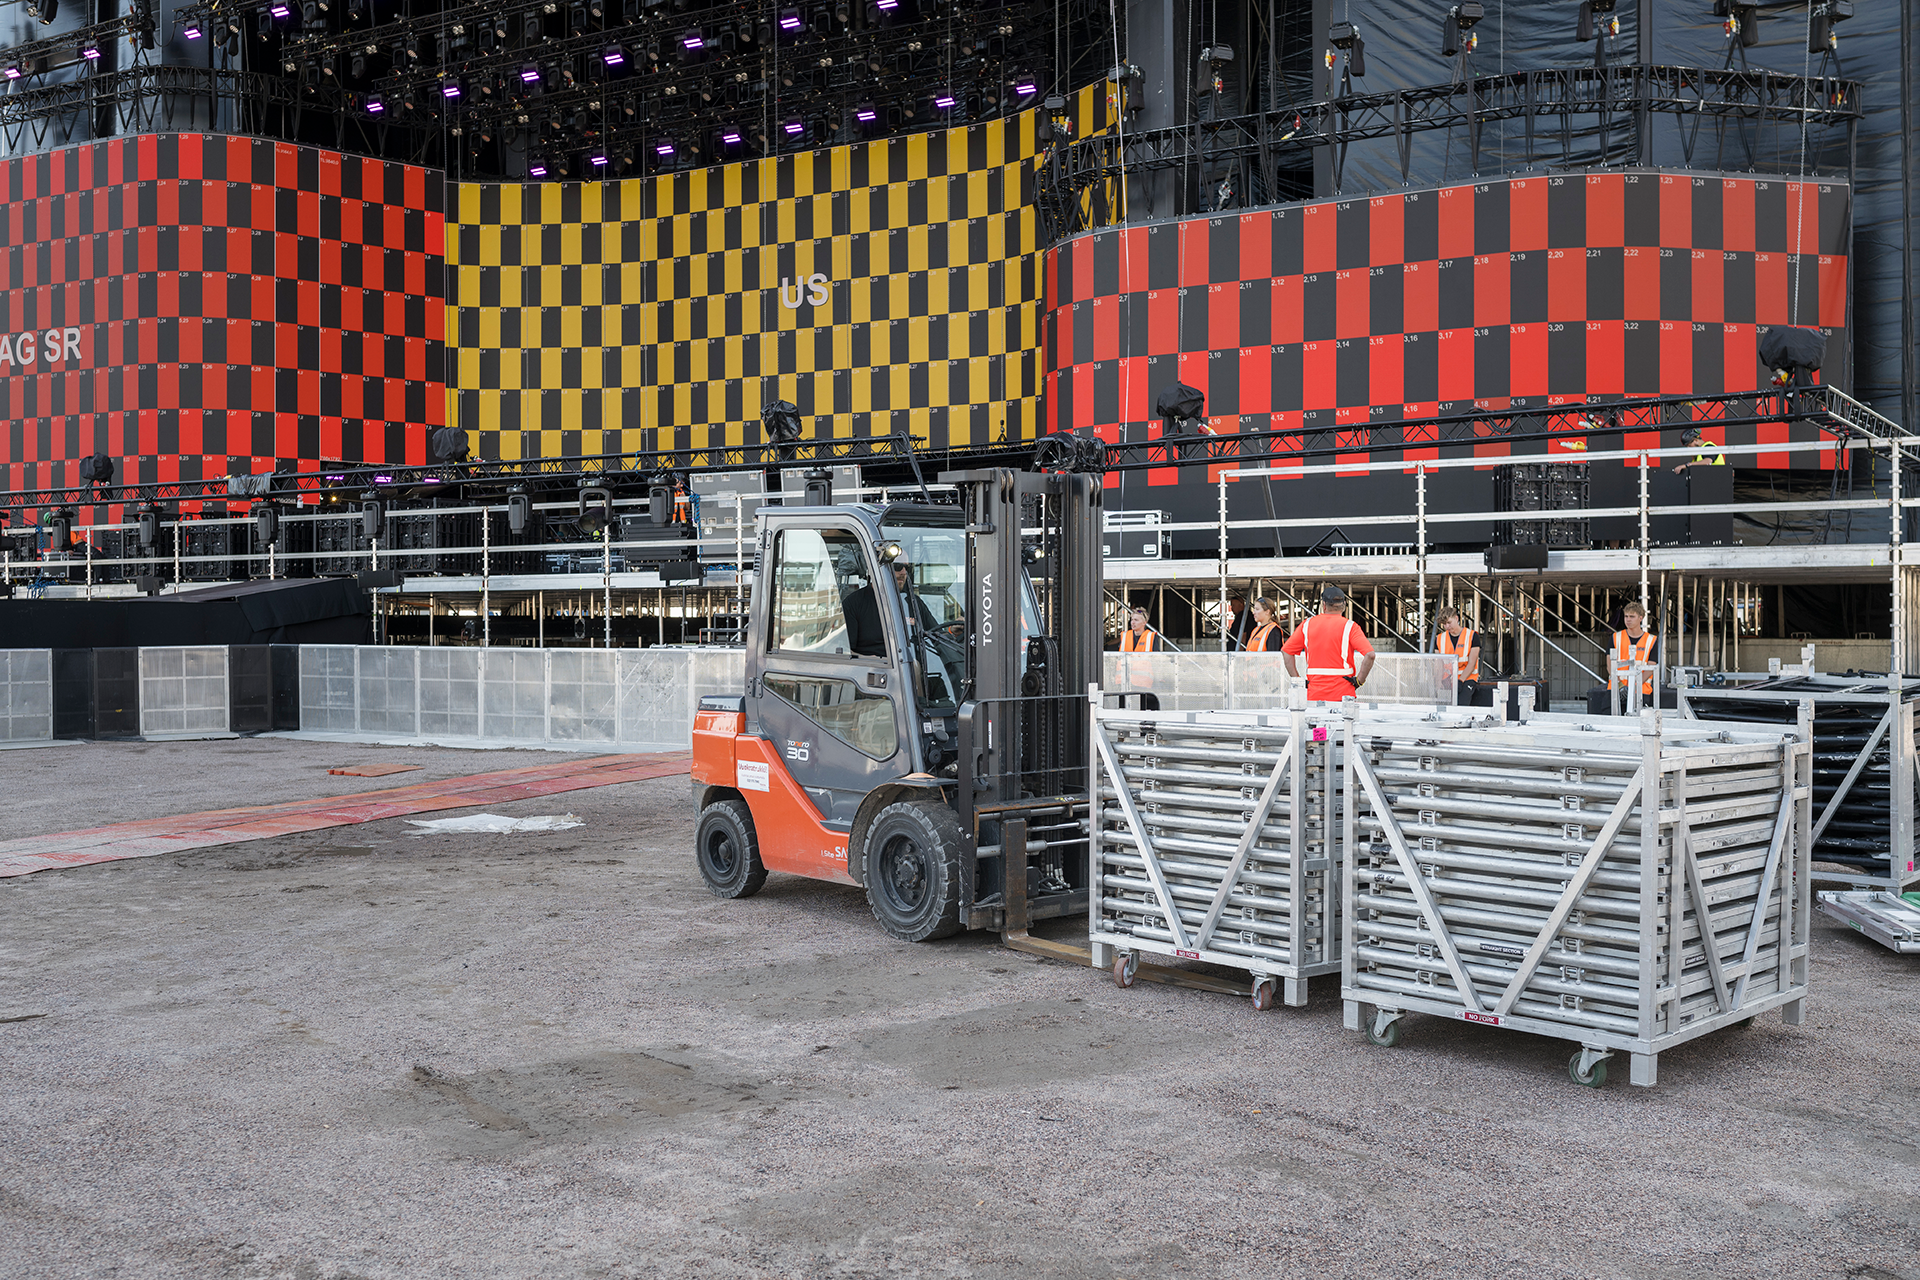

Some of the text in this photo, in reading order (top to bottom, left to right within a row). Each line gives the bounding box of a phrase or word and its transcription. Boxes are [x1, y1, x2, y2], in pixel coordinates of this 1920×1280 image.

[1548, 178, 1564, 187] 1,20
[1586, 177, 1601, 185] 1,21
[1624, 175, 1639, 183] 1,22
[1660, 177, 1674, 185] 1,23
[1692, 178, 1705, 186] 1,24
[1510, 182, 1526, 190] 1,19
[1724, 181, 1738, 189] 1,25
[1756, 181, 1769, 189] 1,26
[1819, 185, 1832, 193] 1,28
[1474, 185, 1490, 194] 1,18
[1404, 193, 1419, 202] 1,16
[1439, 190, 1454, 198] 1,17
[1370, 198, 1384, 207] 1,15
[1304, 206, 1318, 214] 1,13
[1336, 203, 1350, 211] 1,14
[1271, 212, 1285, 220] 1,12
[1148, 227, 1158, 235] 1,8
[1548, 251, 1564, 259] 2,20
[1587, 250, 1601, 258] 2,21
[1624, 249, 1639, 257] 2,22
[1660, 250, 1674, 258] 2,23
[1692, 251, 1705, 259] 2,24
[1724, 253, 1738, 261] 2,25
[1474, 257, 1490, 266] 2,18
[1510, 254, 1526, 262] 2,19
[1755, 254, 1769, 262] 2,26
[1819, 257, 1832, 265] 2,28
[1404, 264, 1419, 273] 2,16
[1439, 261, 1454, 269] 2,17
[1336, 272, 1350, 280] 2,14
[1370, 268, 1384, 276] 2,15
[1271, 279, 1285, 287] 2,12
[1304, 275, 1318, 283] 2,13
[782, 273, 829, 309] US
[1148, 292, 1158, 300] 2,8
[1510, 326, 1526, 334] 3,19
[1548, 324, 1564, 333] 3,20
[1587, 323, 1601, 331] 3,21
[1624, 323, 1639, 331] 3,22
[1660, 323, 1674, 331] 3,23
[1692, 324, 1706, 332] 3,24
[1724, 325, 1738, 333] 3,25
[1439, 332, 1454, 340] 3,17
[1474, 329, 1490, 337] 3,18
[1370, 338, 1384, 346] 3,15
[1404, 335, 1419, 343] 3,16
[44, 327, 82, 363] SR
[1336, 341, 1350, 349] 3,14
[1240, 349, 1252, 357] 3,11
[1271, 346, 1285, 354] 3,12
[1209, 352, 1222, 360] 3,10
[1148, 357, 1158, 365] 3,8
[1510, 399, 1526, 407] 4,19
[1548, 397, 1565, 406] 4,20
[1586, 396, 1601, 404] 4,21
[1404, 405, 1419, 413] 4,16
[1438, 403, 1453, 411] 4,17
[1474, 401, 1490, 410] 4,18
[1336, 410, 1350, 418] 4,14
[1369, 407, 1384, 416] 4,15
[1271, 414, 1285, 422] 4,12
[1303, 412, 1317, 420] 4,13
[1208, 418, 1222, 426] 4,10
[982, 572, 993, 647] TOYOTA
[786, 747, 809, 762] 30
[835, 846, 849, 859] SA
[1468, 1013, 1496, 1024] NO FORK
